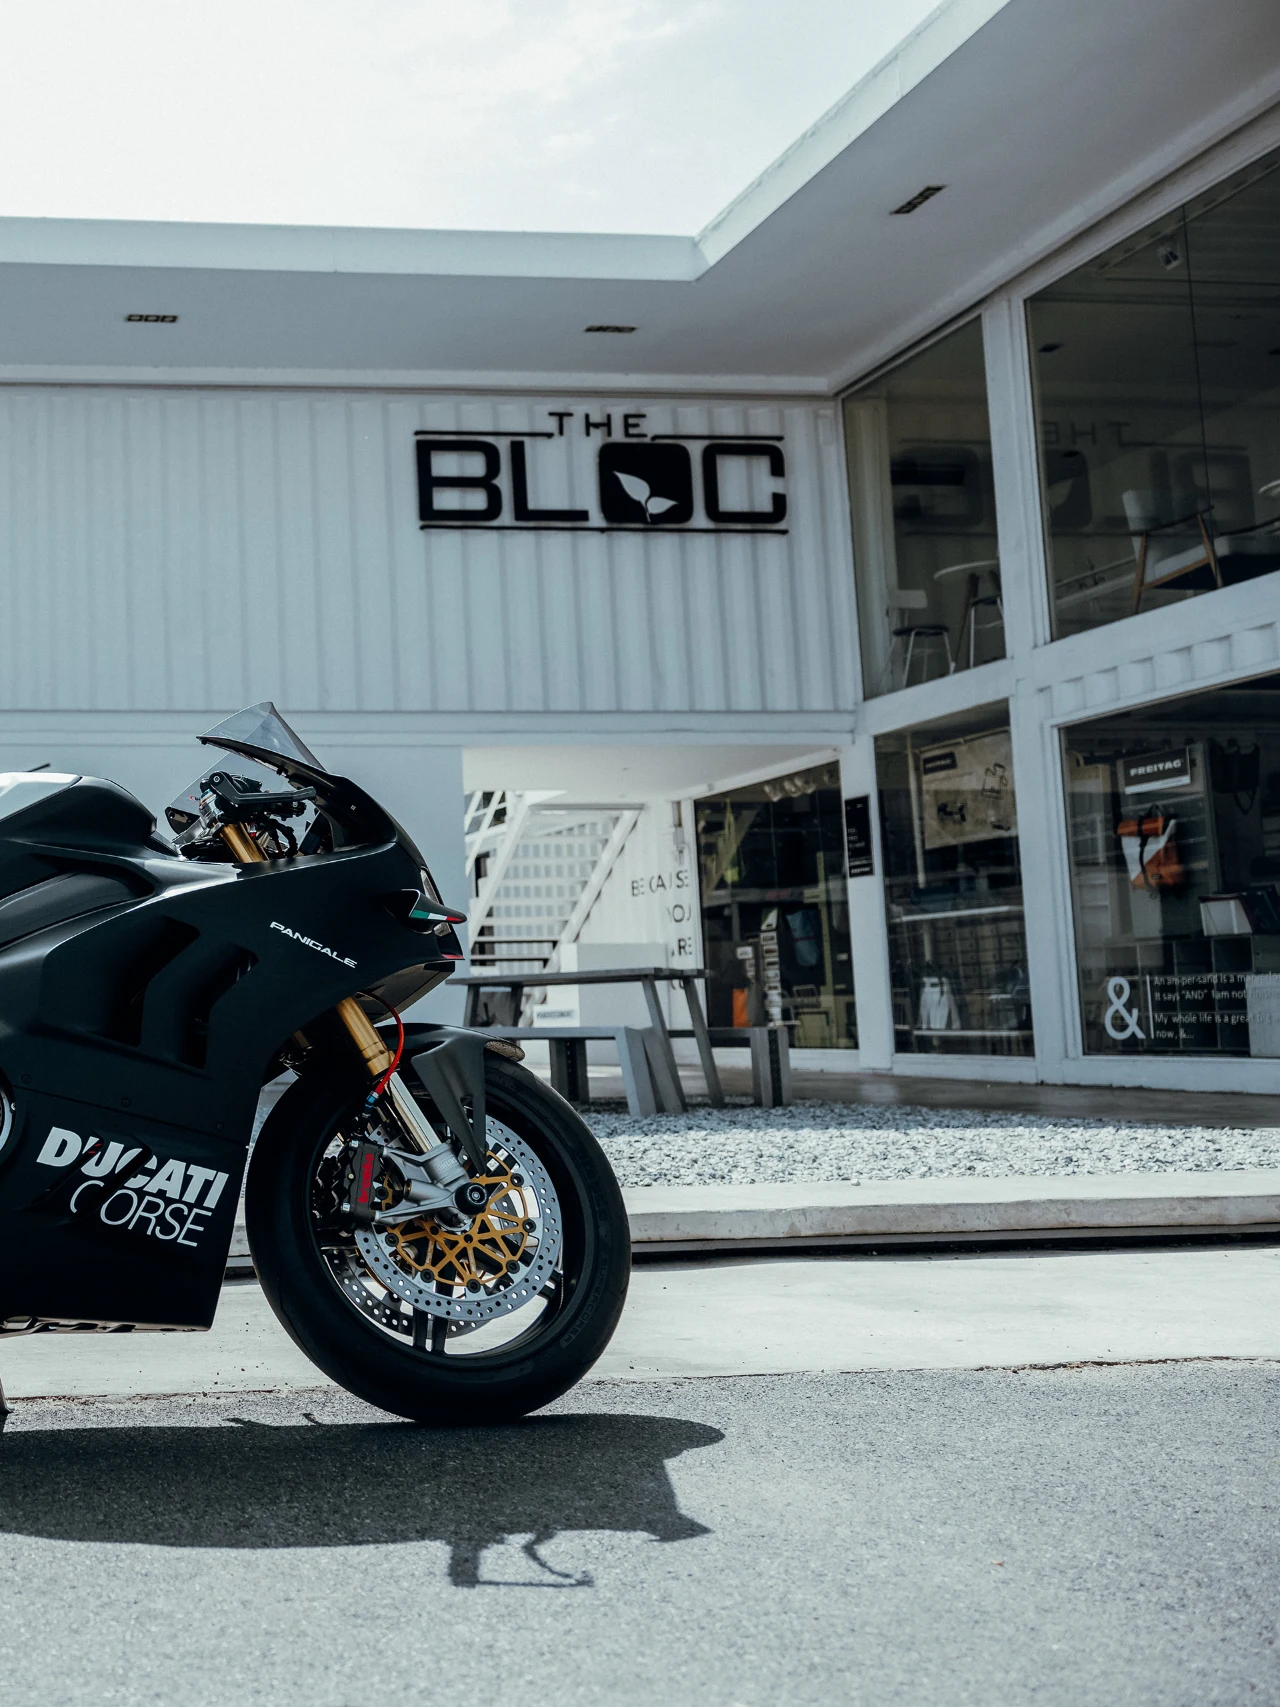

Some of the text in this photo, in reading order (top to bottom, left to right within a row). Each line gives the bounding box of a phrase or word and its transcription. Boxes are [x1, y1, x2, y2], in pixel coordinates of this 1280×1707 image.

[548, 410, 648, 438] THE
[415, 439, 788, 524] BLOC
[1129, 758, 1182, 777] FREITAG
[270, 921, 358, 969] PANIGALE
[1229, 974, 1235, 984] a
[1231, 990, 1247, 1000] not
[1104, 976, 1147, 1041] &
[1154, 1013, 1168, 1025] My
[1172, 1012, 1197, 1023] whole
[1199, 1012, 1212, 1023] life
[1215, 1013, 1222, 1023] is
[1223, 1014, 1229, 1023] a
[36, 1126, 229, 1209] DUCATI
[357, 1153, 375, 1203] brembo
[70, 1180, 212, 1247] CORSE
